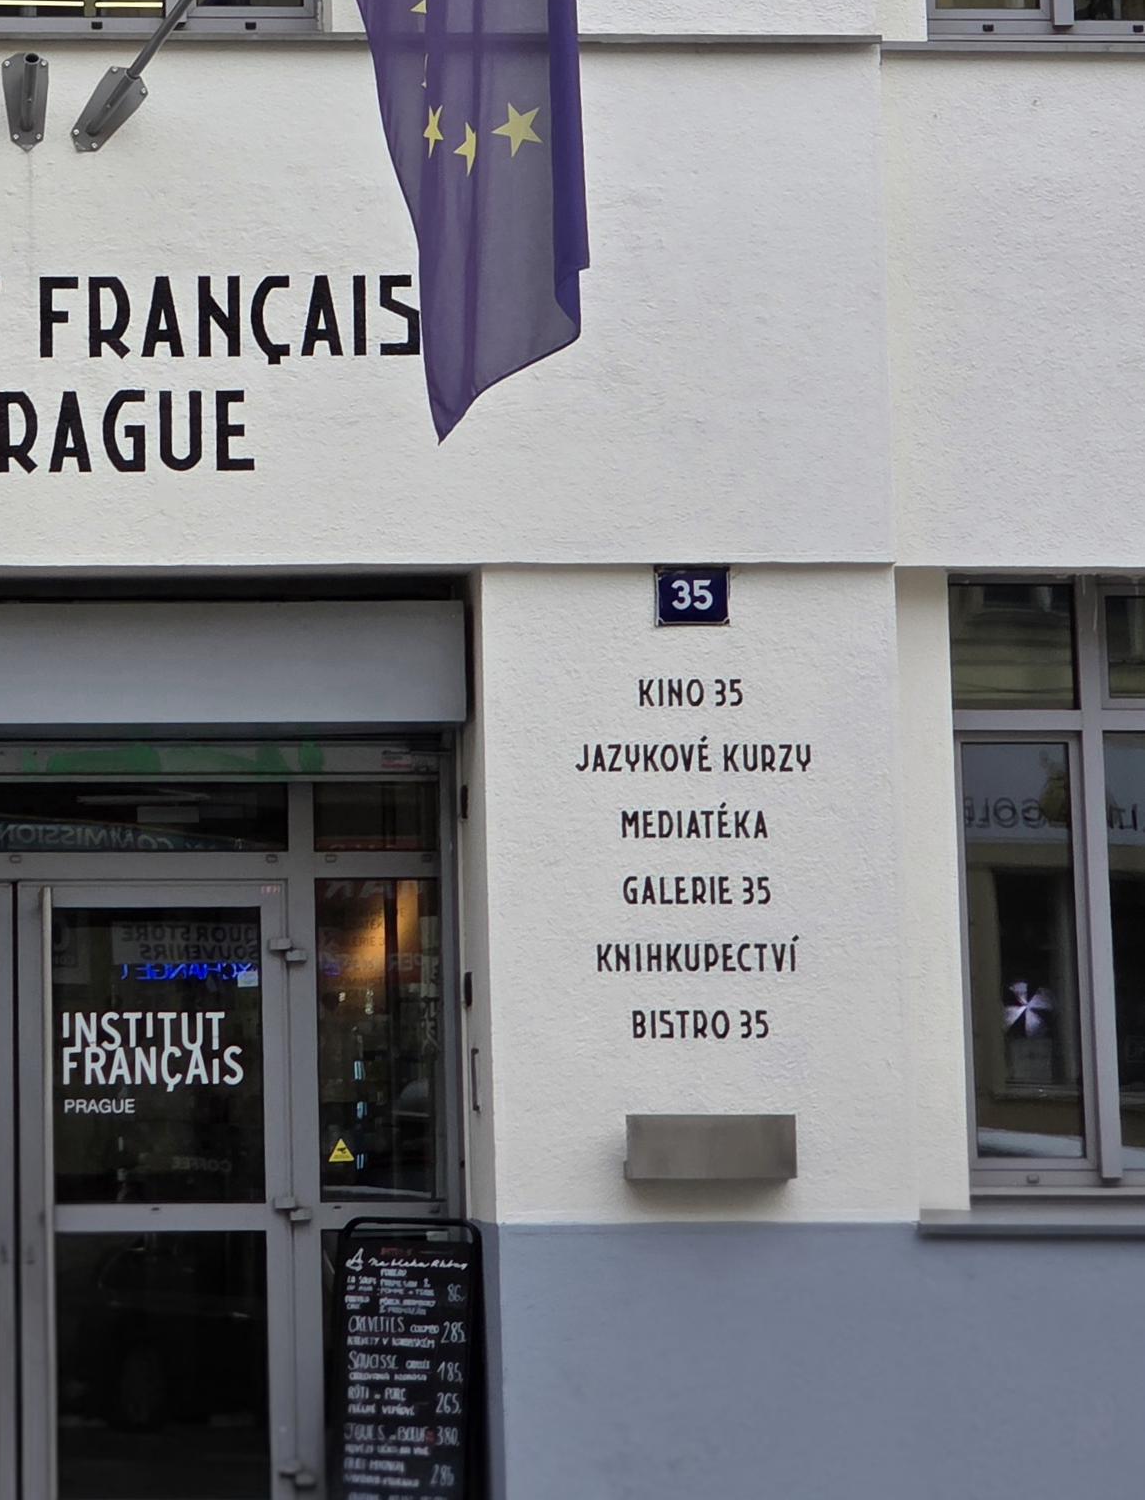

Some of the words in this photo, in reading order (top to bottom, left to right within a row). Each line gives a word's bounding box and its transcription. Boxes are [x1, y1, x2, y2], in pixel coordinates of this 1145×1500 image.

[39, 274, 421, 365] FRANÇAIS
[670, 578, 714, 611] 35
[638, 678, 705, 708] KINO
[714, 678, 744, 707] 35
[575, 735, 713, 773] JAZYKOVÉ
[722, 744, 812, 773] KURZY
[621, 802, 769, 839] MEDIATÉKA
[623, 876, 733, 905] GALERIE
[742, 876, 772, 905] 35
[596, 934, 800, 972] KNIHKUPECTVÍ
[62, 1011, 226, 1051] INSTITUT
[632, 1010, 731, 1040] BISTRO
[740, 1010, 770, 1039] 35
[63, 1098, 136, 1114] PRAGUE
